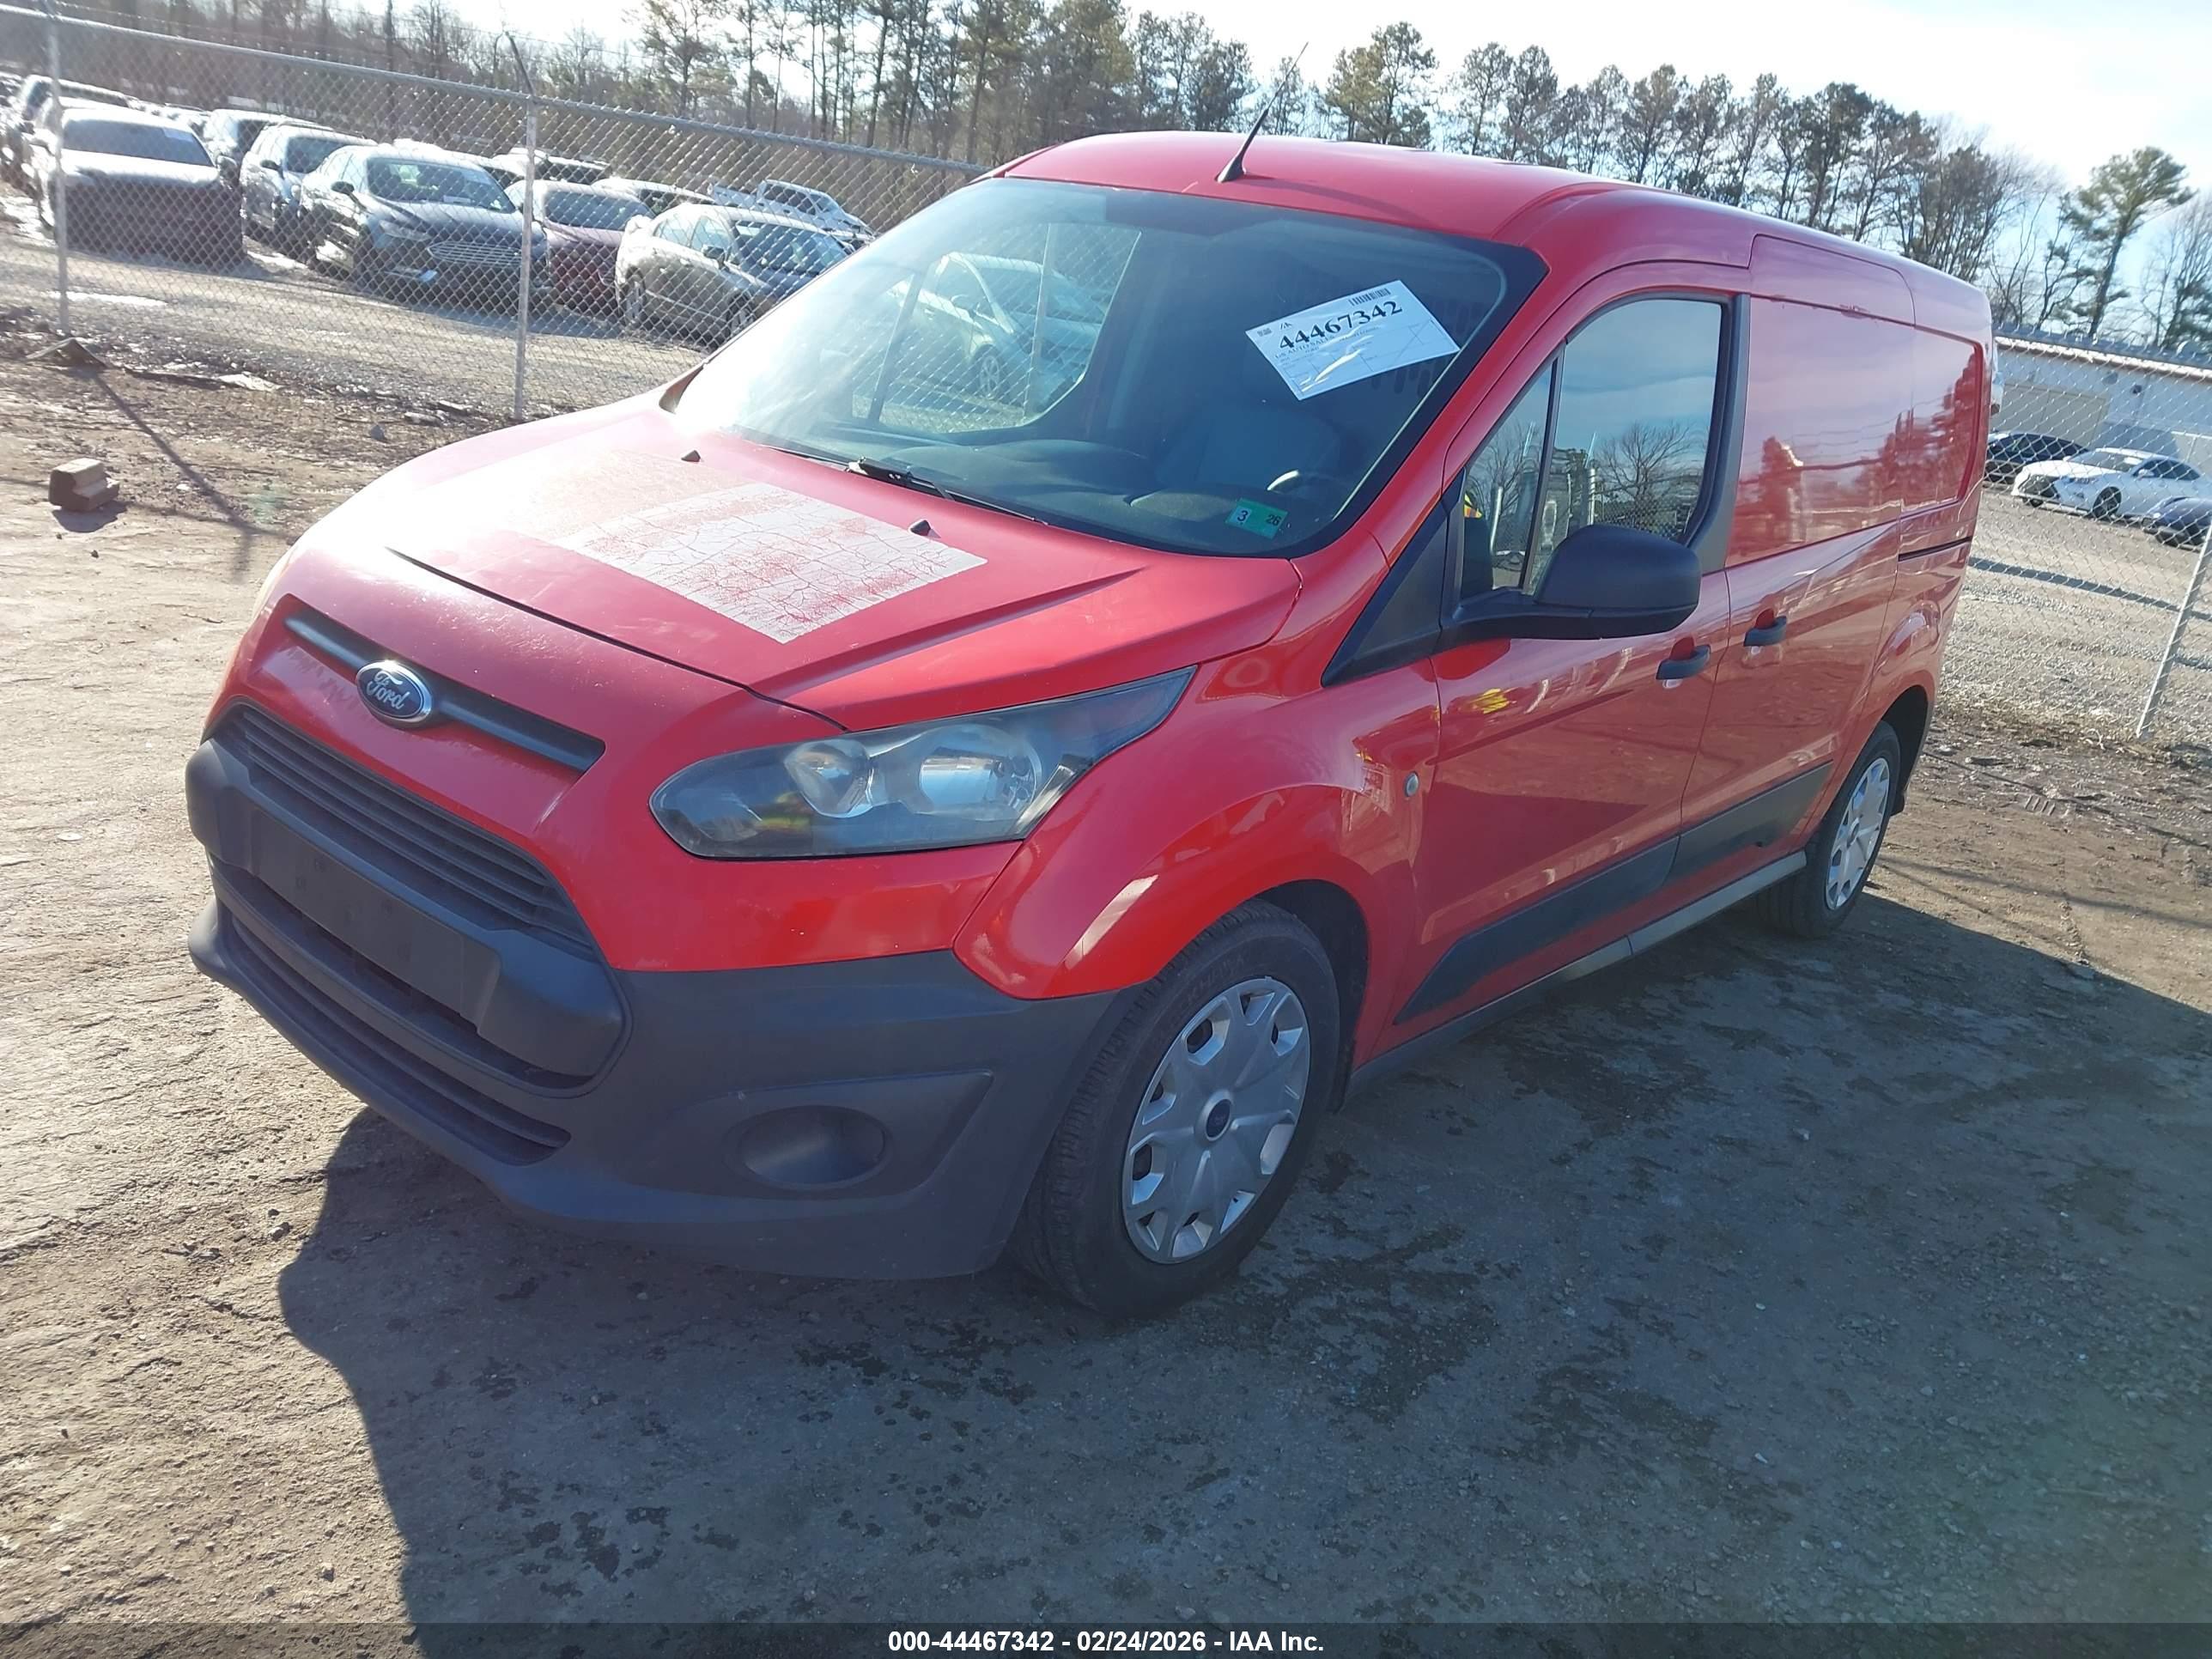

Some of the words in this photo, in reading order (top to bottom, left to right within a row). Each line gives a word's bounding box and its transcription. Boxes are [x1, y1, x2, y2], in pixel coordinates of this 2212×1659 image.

[1279, 301, 1402, 349] 44467342
[1237, 510, 1249, 522] 3
[1266, 514, 1282, 526] 26
[366, 670, 411, 709] Ford
